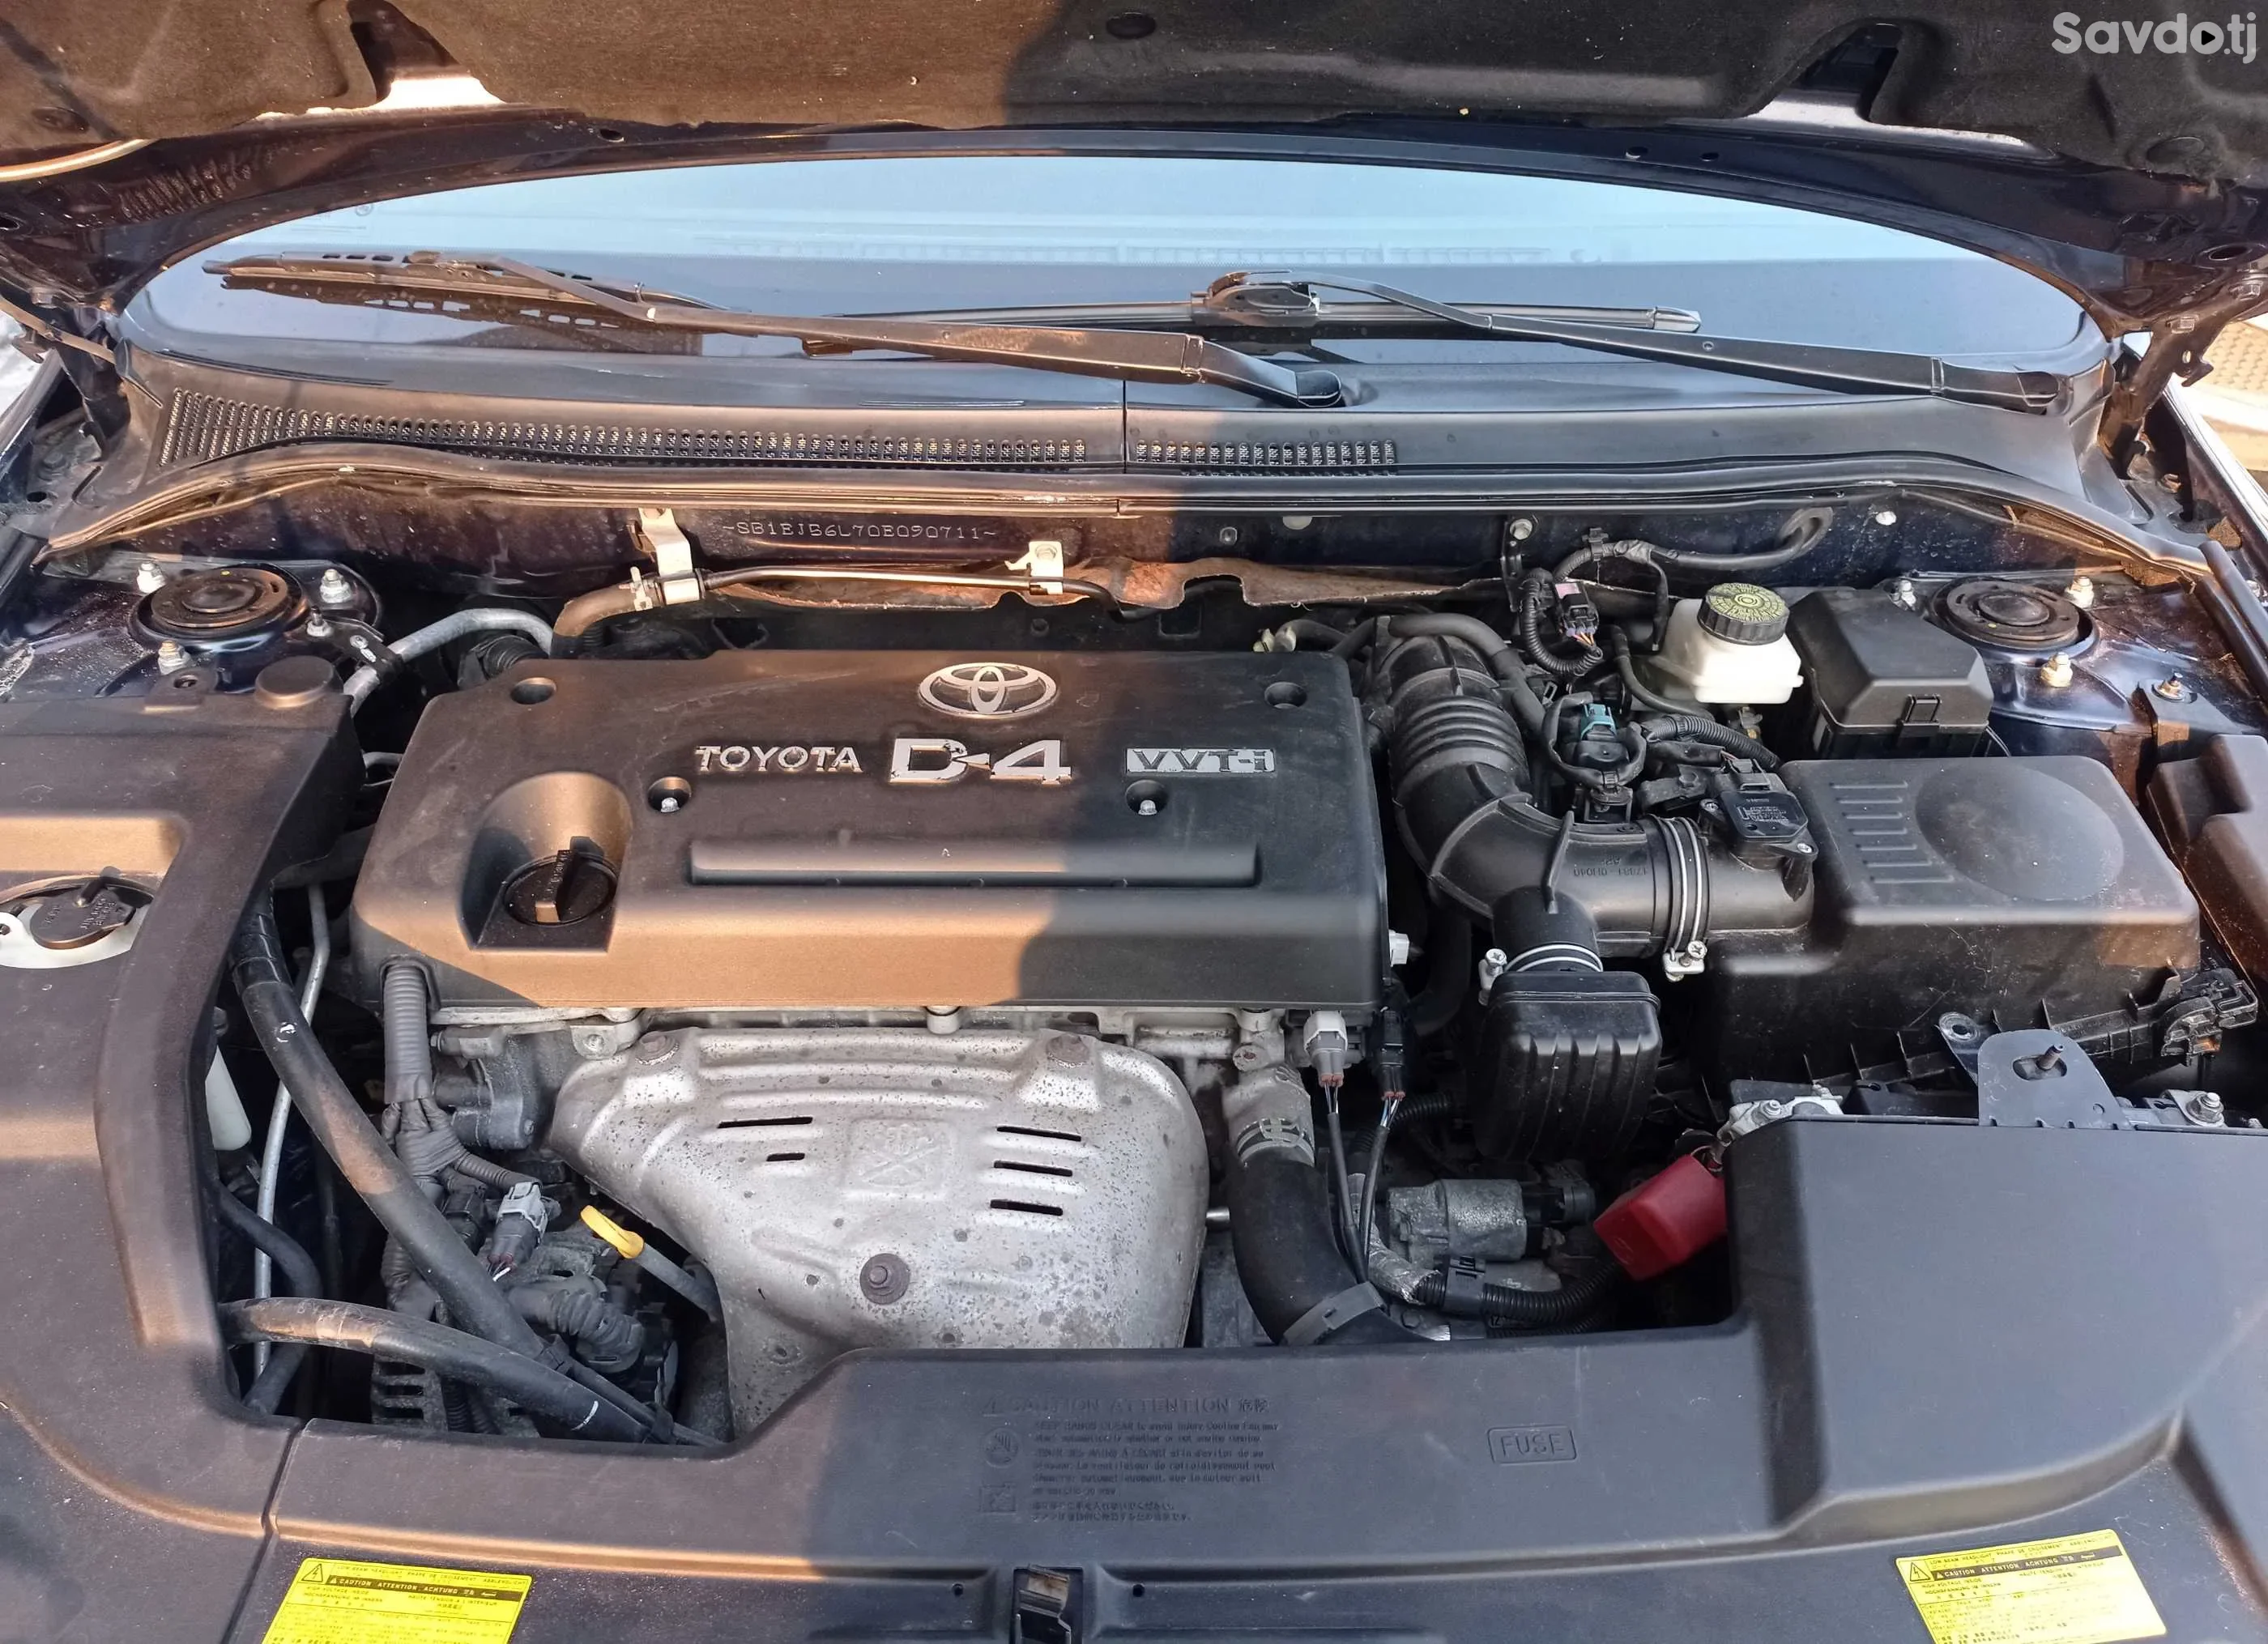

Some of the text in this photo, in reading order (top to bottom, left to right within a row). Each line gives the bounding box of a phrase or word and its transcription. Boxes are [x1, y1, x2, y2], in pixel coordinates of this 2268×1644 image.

[695, 745, 863, 773] TOYOTA
[889, 738, 1074, 785] D-4
[1130, 750, 1270, 772] VVT-i
[1500, 1433, 1565, 1458] FUSE
[1944, 1569, 1976, 1577] CAUTION
[1981, 1563, 2019, 1574] ATTENTION
[2024, 1557, 2059, 1568] ACHTUNG
[339, 1578, 371, 1587] CAUTION
[377, 1582, 418, 1591] ATTENTION
